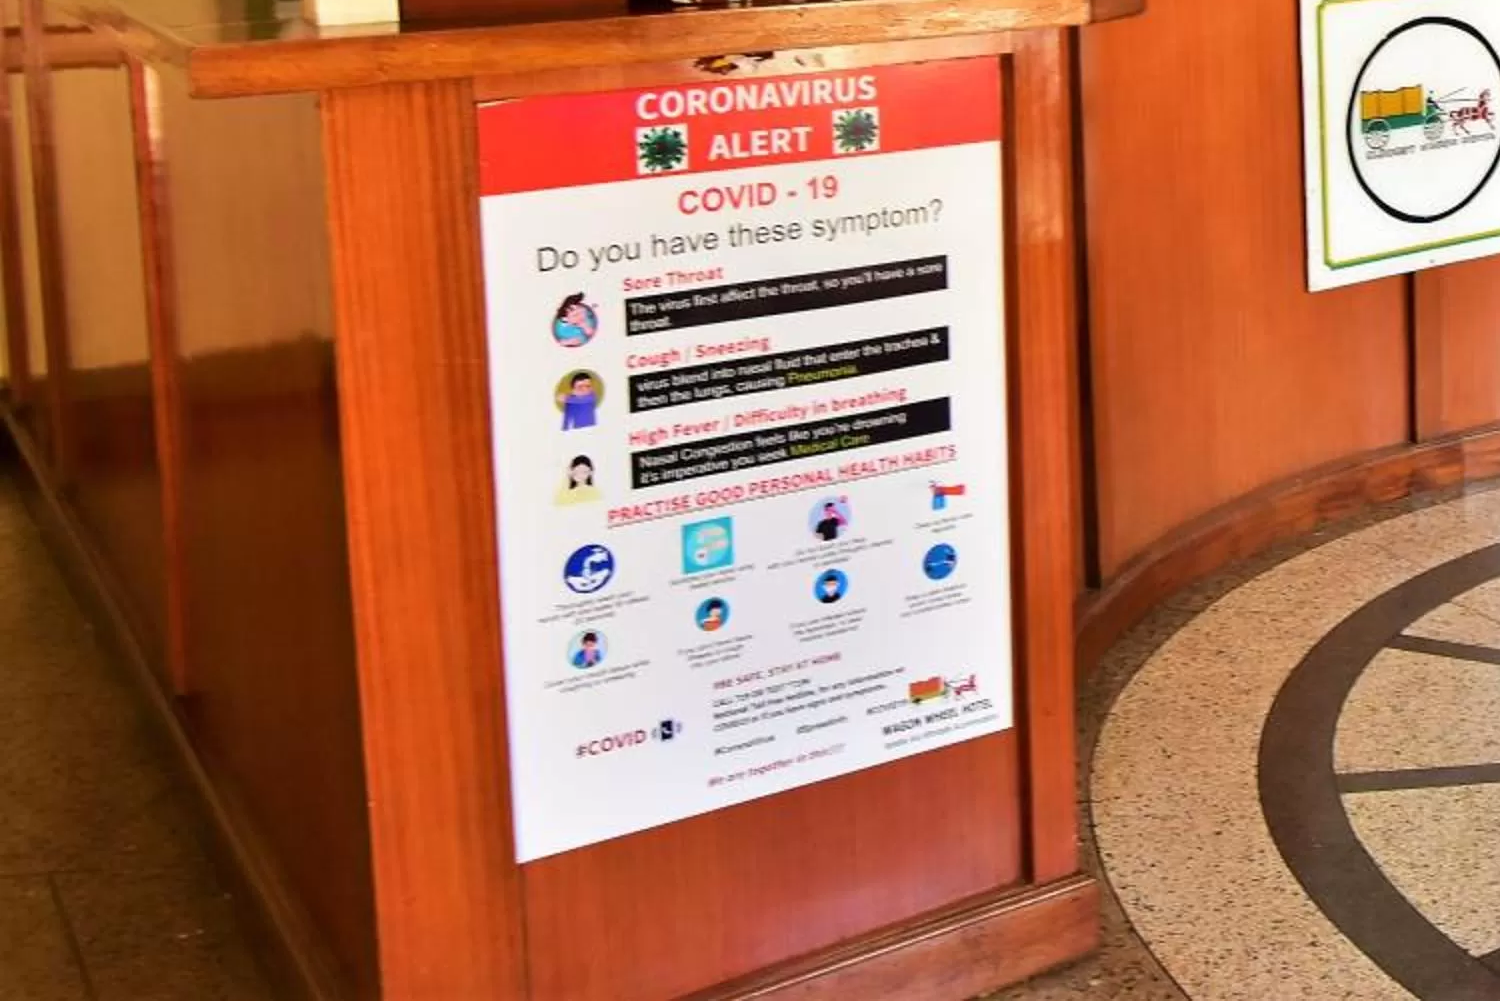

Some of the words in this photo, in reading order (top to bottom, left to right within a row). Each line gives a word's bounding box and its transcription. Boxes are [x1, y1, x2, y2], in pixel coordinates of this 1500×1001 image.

[636, 75, 877, 120] CORONAVIRUS
[709, 126, 813, 161] ALERT
[678, 182, 777, 215] COVID
[806, 175, 838, 199] 19
[537, 245, 579, 272] Do
[588, 241, 640, 271] you
[651, 231, 719, 258] have
[728, 220, 803, 247] these
[811, 198, 944, 241] symptom?
[623, 276, 661, 292] Sore
[666, 267, 723, 287] Throat
[630, 302, 657, 315] The
[658, 299, 692, 311] virus
[693, 293, 719, 306] first
[873, 269, 905, 282] have
[627, 350, 681, 369] Cough
[695, 337, 769, 358] Sneezing
[637, 378, 670, 391] virus
[710, 368, 736, 380] into
[669, 391, 693, 403] the
[735, 376, 786, 393] causing
[629, 426, 668, 446] High
[673, 420, 720, 436] Fever
[734, 406, 807, 428] Difficulty
[813, 401, 828, 412] in
[832, 388, 907, 411] breathing
[639, 451, 678, 467] Nasal
[730, 456, 755, 470] you
[608, 493, 691, 522] PRACTISE
[695, 484, 745, 506] GOOD
[749, 469, 831, 498] PERSONAL
[839, 457, 898, 481] HEALTH
[903, 445, 957, 467] HABITS
[576, 729, 647, 759] #COVID
